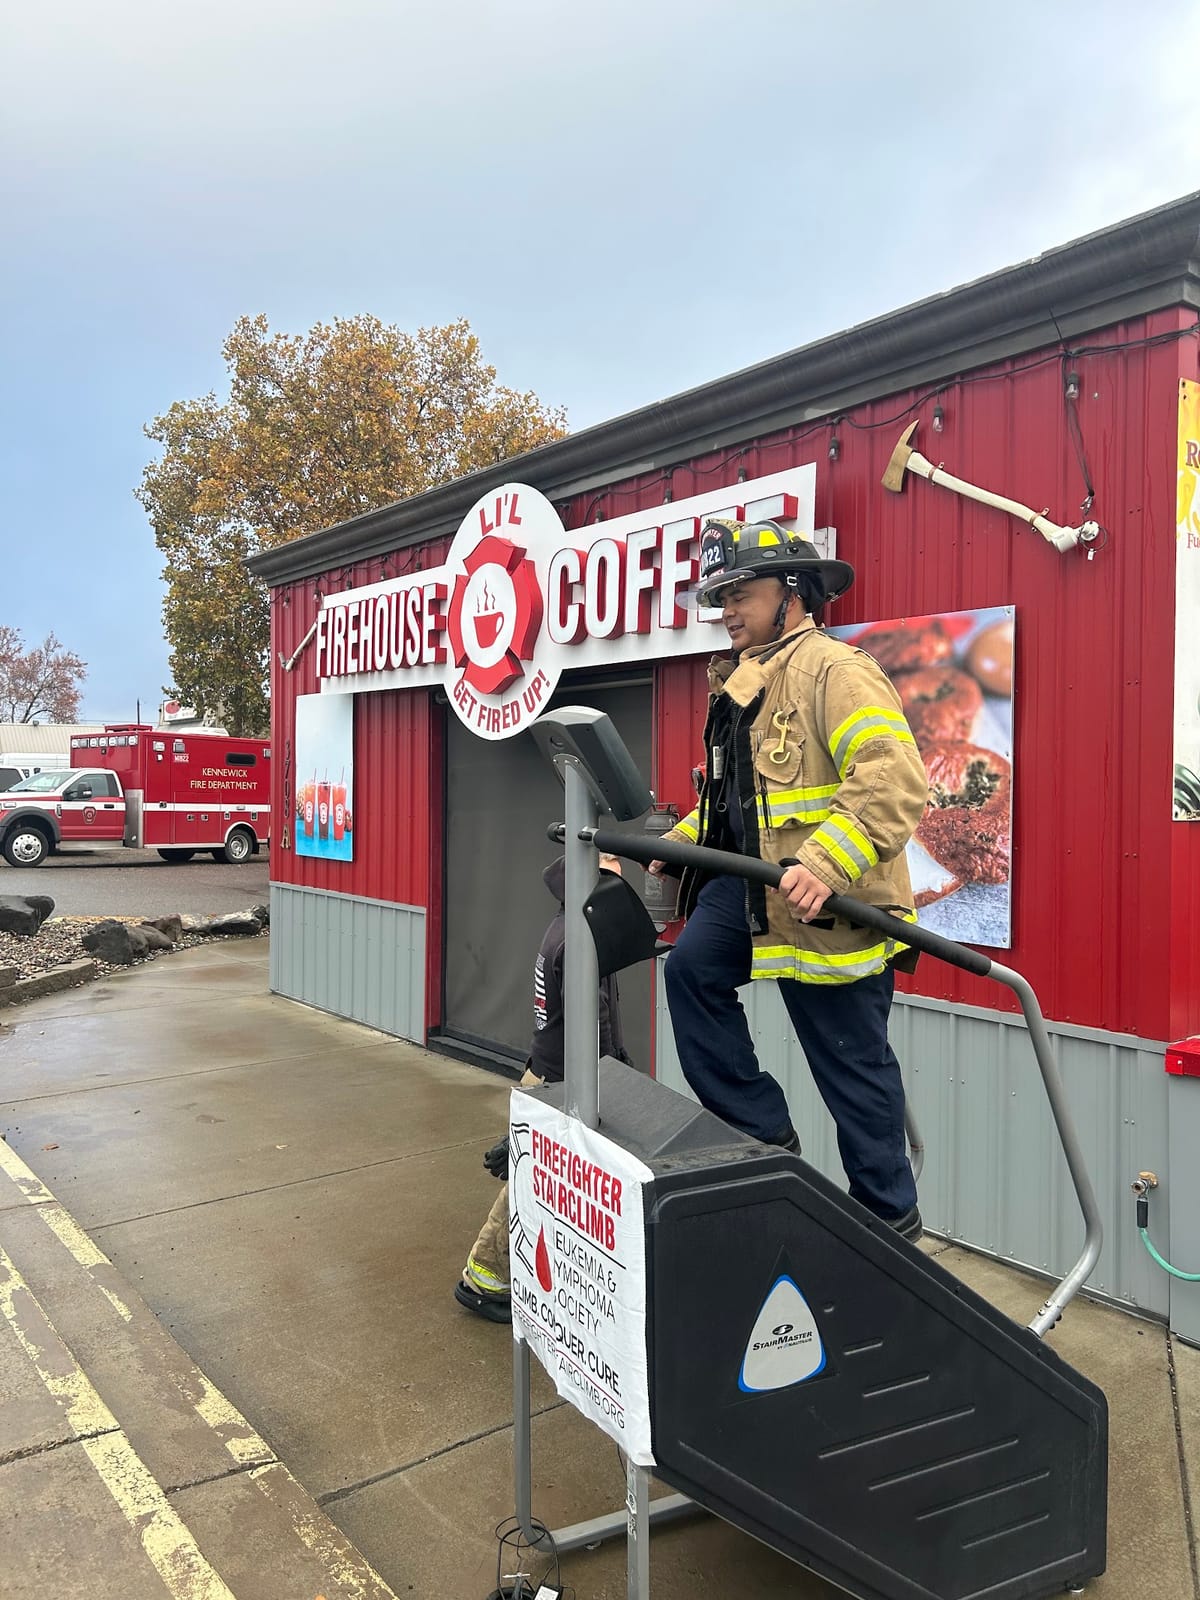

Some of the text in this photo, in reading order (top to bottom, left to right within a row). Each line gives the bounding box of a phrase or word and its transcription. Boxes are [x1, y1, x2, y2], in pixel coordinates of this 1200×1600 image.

[1186, 440, 1200, 469] R
[548, 492, 798, 645] COFF
[315, 583, 447, 679] FIREHOUSE
[453, 669, 551, 733] GET FIRED UP!
[190, 780, 258, 790] FIRE DEPARTMENT
[202, 767, 248, 778] KENNEWICK
[532, 1129, 623, 1217] FIREFIGHTER
[533, 1165, 616, 1252] STAIRCLIMB
[607, 1270, 616, 1293] &
[513, 1277, 540, 1317] CLIMB.
[588, 1350, 622, 1398] CURE.
